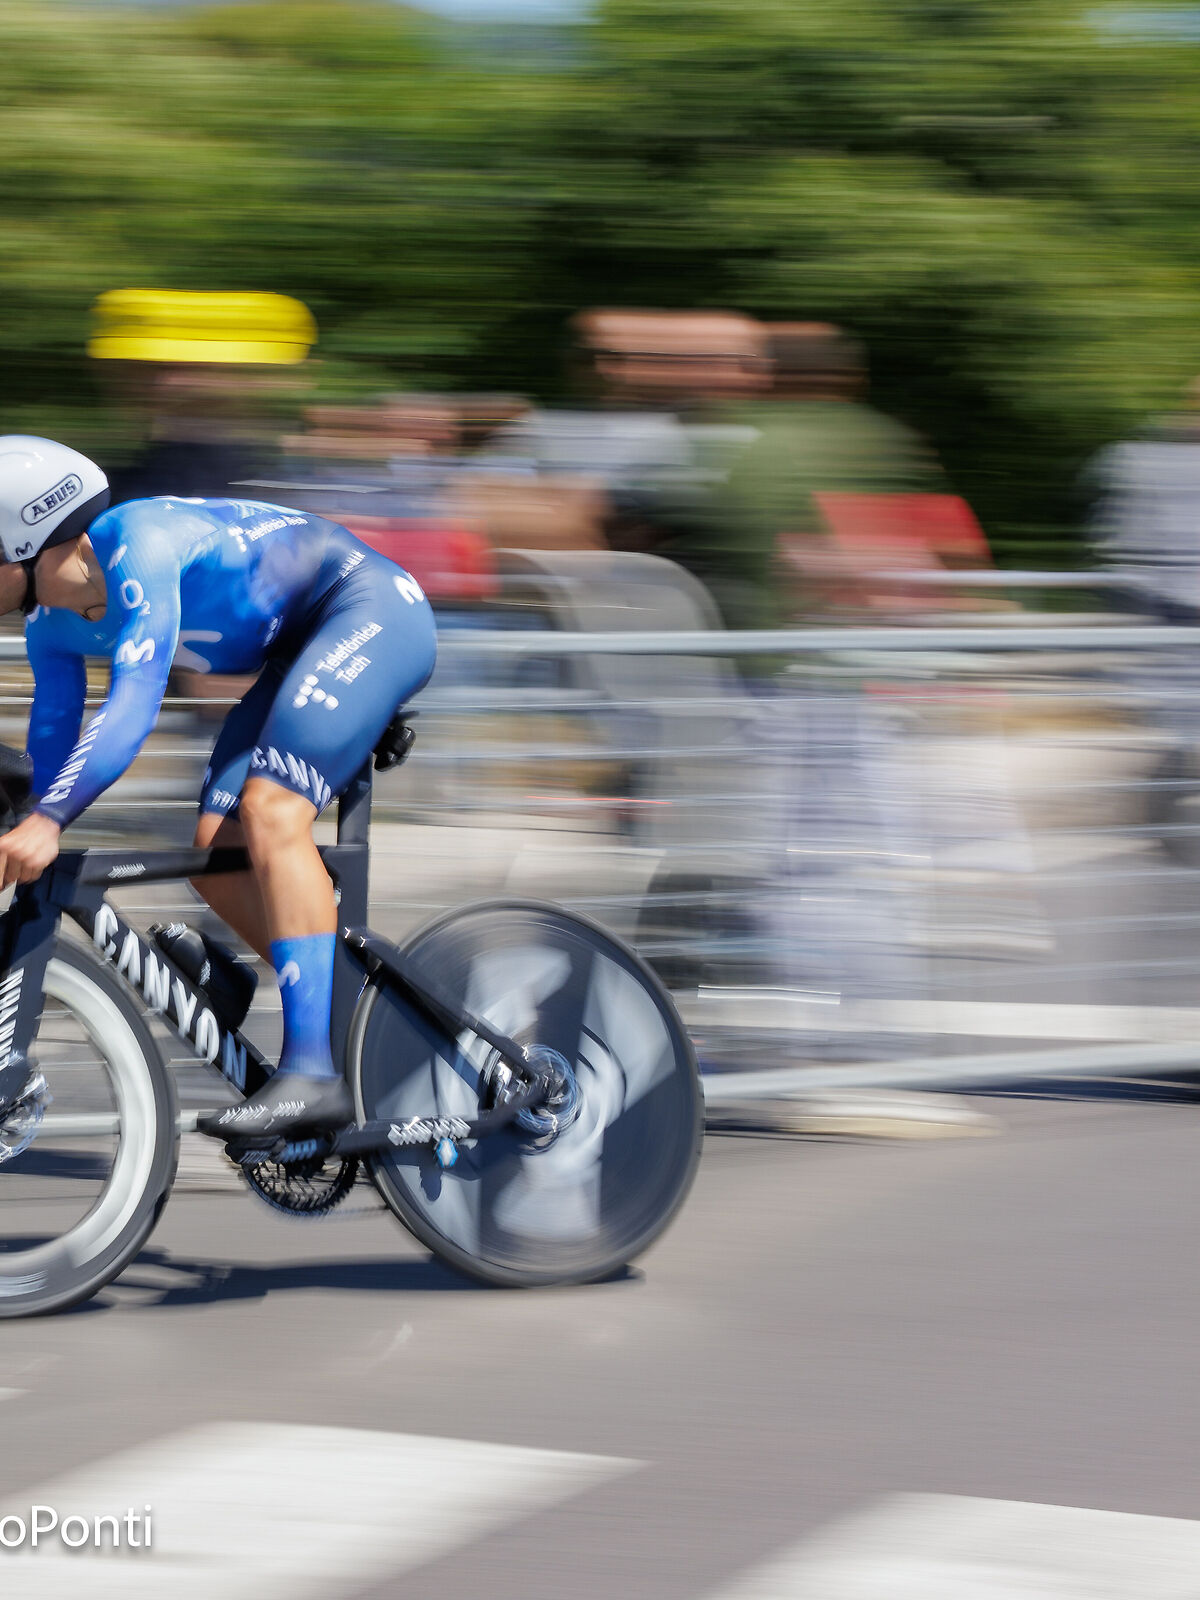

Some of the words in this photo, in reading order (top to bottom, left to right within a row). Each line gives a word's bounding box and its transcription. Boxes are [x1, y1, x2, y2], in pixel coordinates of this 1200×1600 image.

[30, 478, 77, 520] ABUS
[335, 655, 372, 685] Tech
[93, 902, 248, 1094] CANYON
